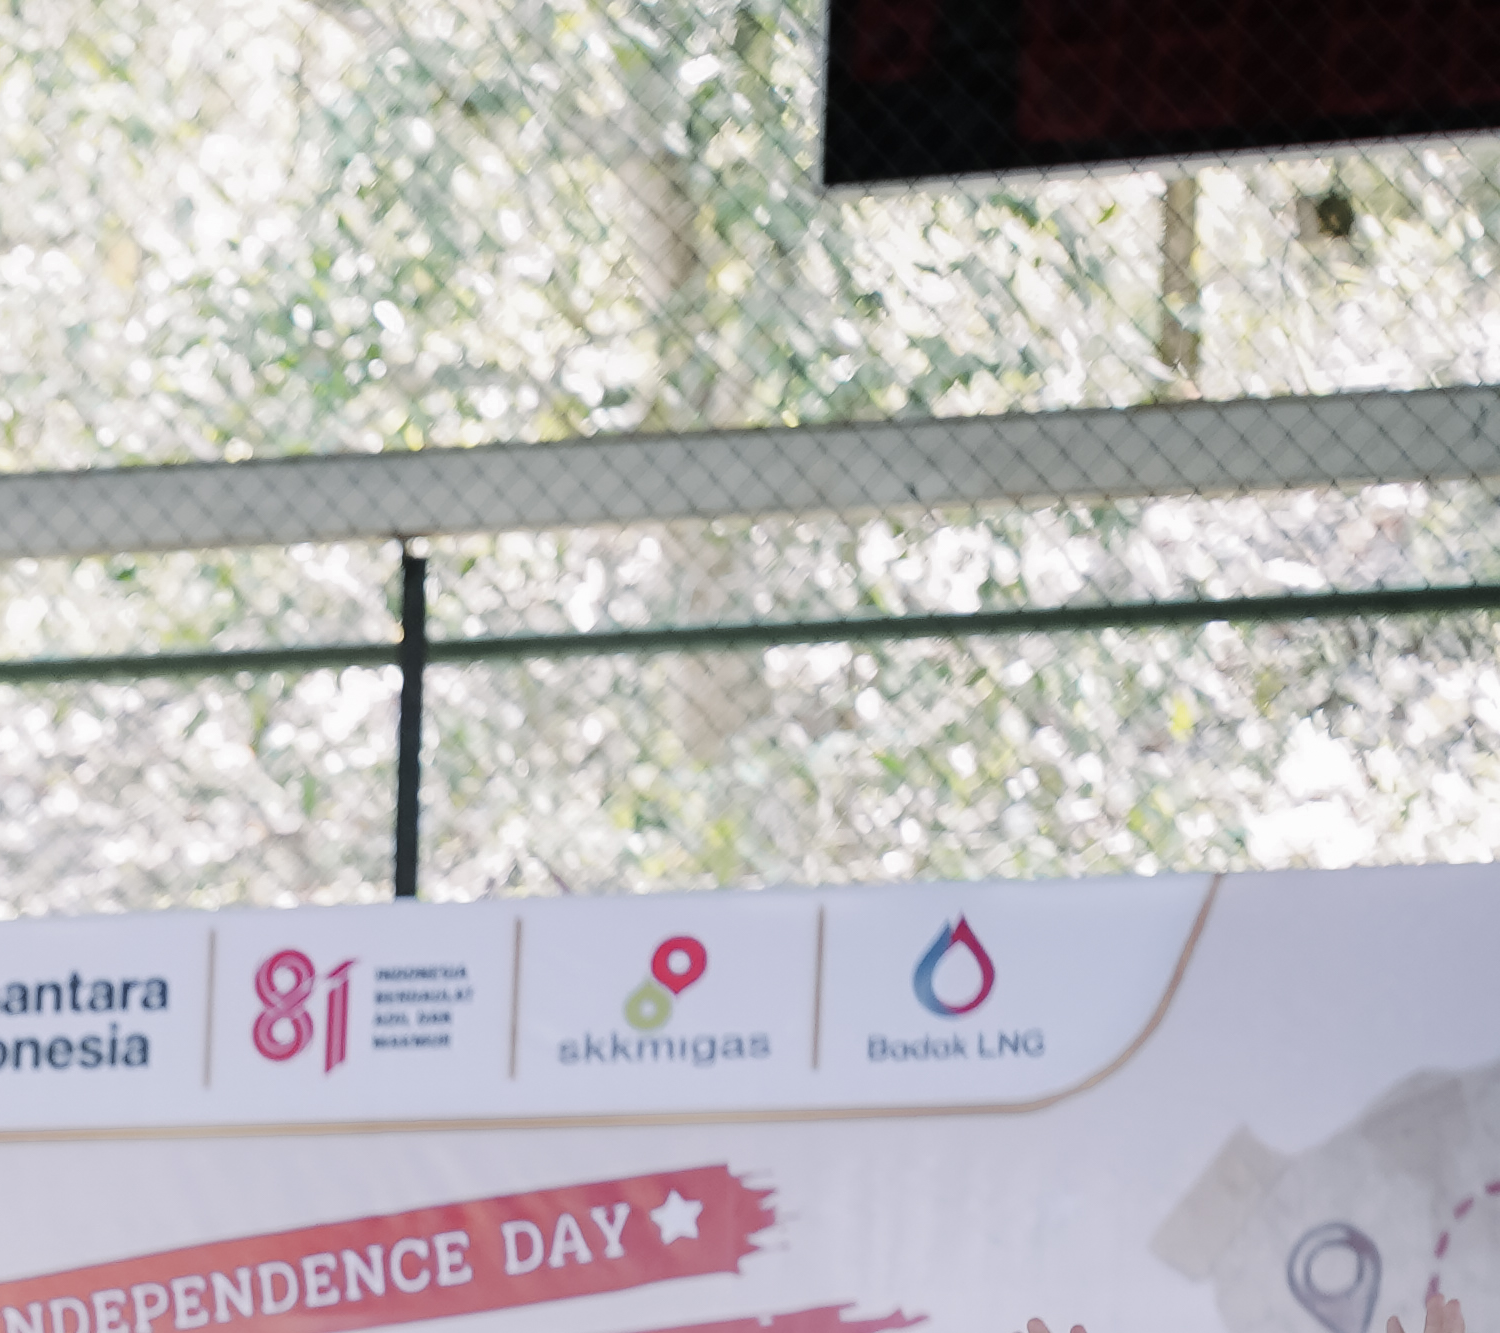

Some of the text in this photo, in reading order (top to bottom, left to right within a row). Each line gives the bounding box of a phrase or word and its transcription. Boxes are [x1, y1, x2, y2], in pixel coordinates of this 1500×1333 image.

[253, 948, 358, 1075] 81
[867, 1027, 1046, 1063] Badak LNG
[558, 1031, 772, 1067] skkmigas
[502, 1201, 633, 1299] DAY
